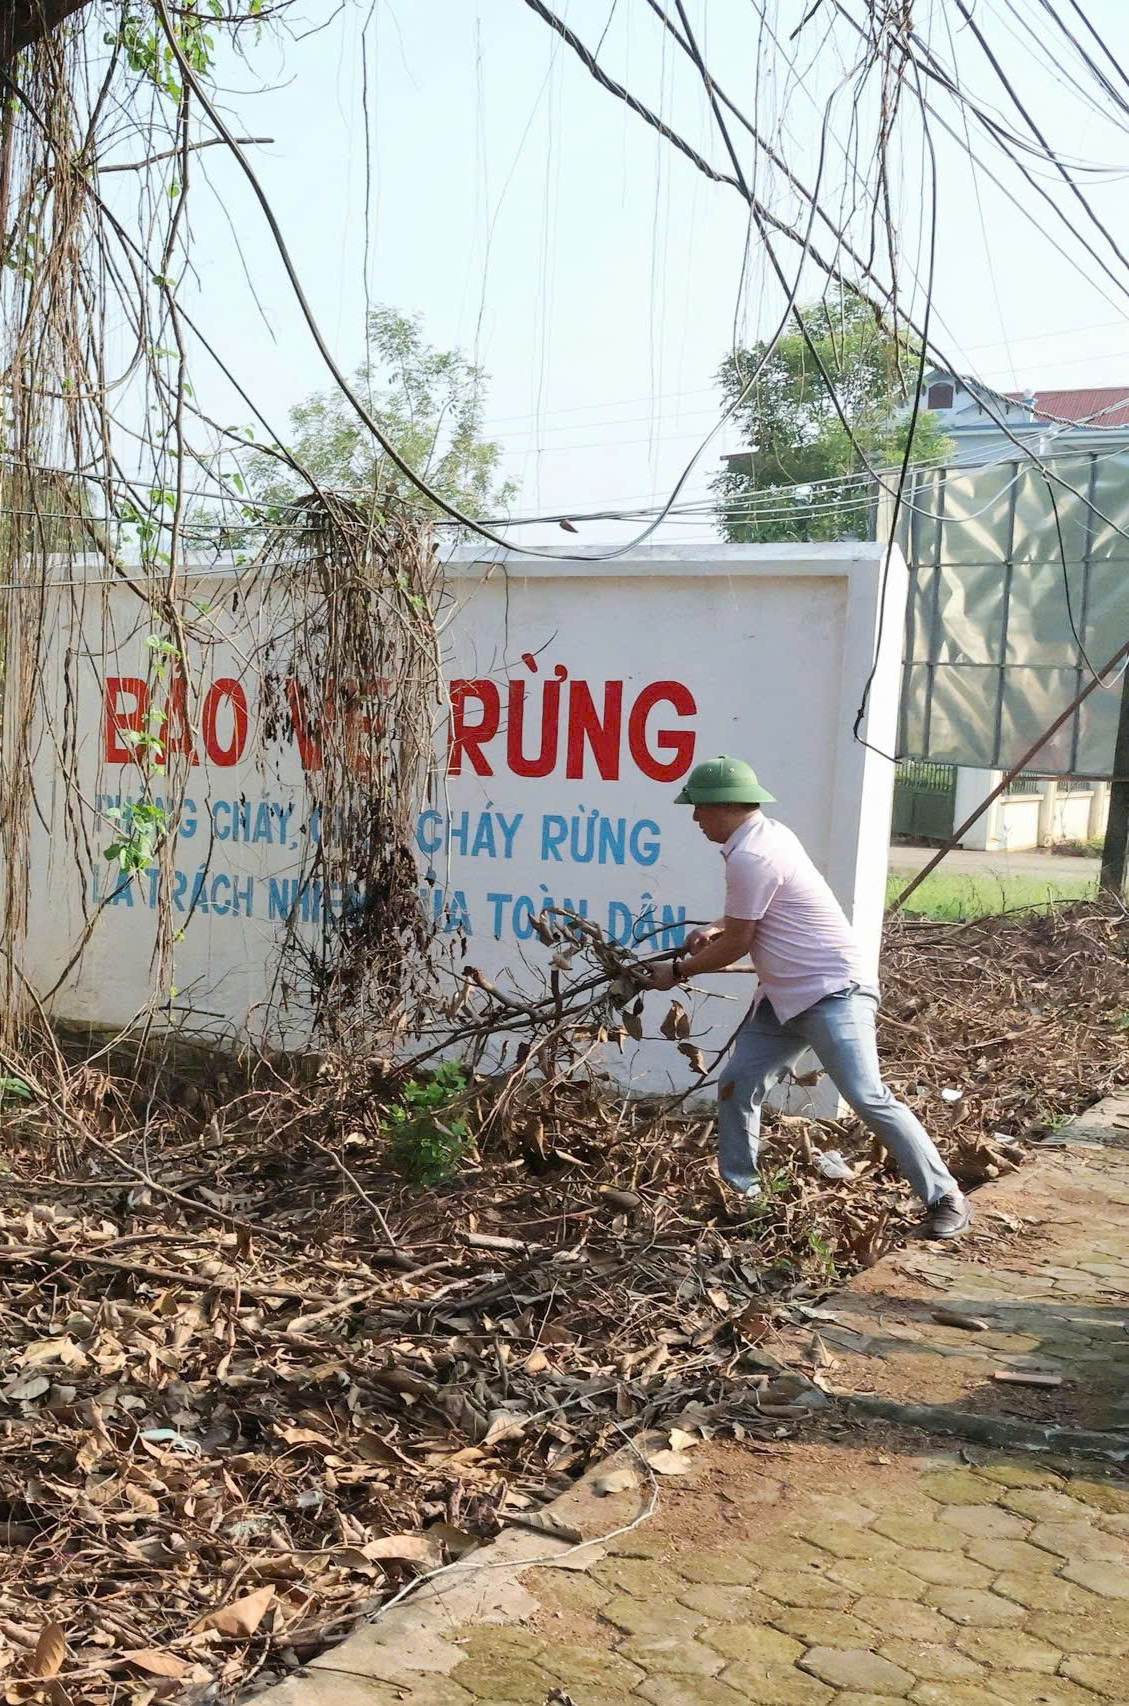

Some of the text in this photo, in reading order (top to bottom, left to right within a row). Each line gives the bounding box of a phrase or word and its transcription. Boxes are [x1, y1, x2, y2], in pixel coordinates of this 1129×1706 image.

[446, 653, 698, 783] RỪNG
[416, 801, 524, 859] CHÁY
[541, 804, 662, 867] RỪNG
[144, 863, 254, 917] TRÁCH
[607, 892, 687, 952] DÂN
